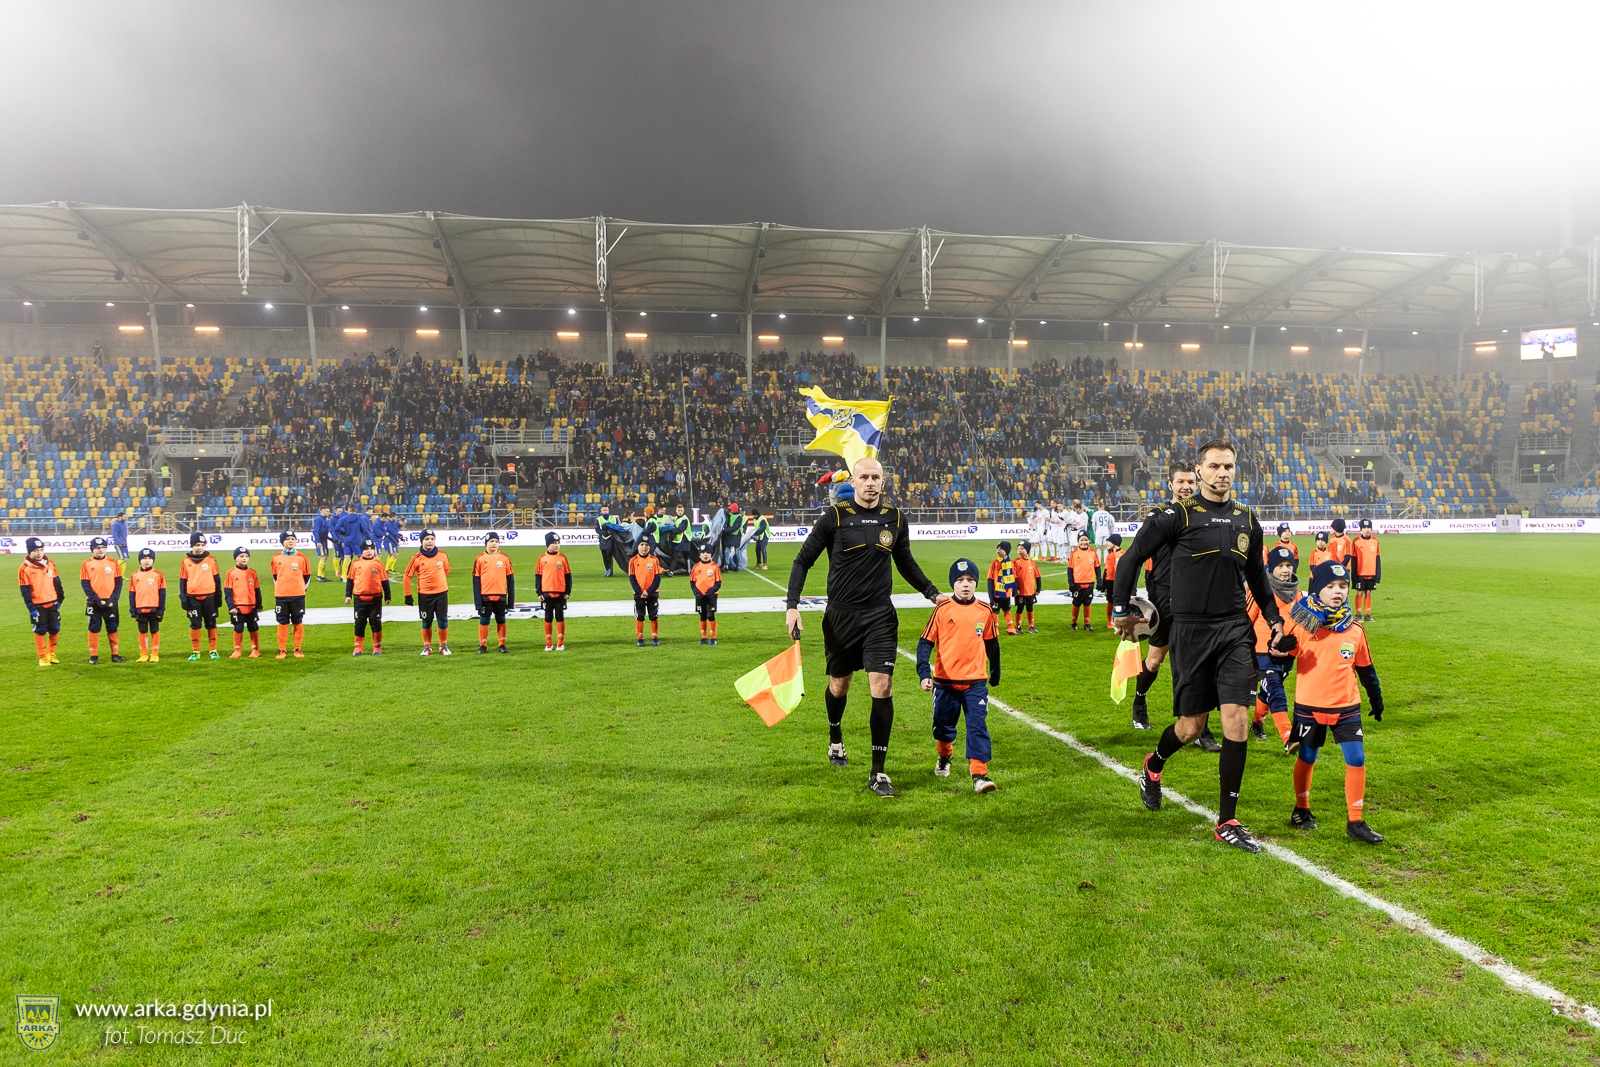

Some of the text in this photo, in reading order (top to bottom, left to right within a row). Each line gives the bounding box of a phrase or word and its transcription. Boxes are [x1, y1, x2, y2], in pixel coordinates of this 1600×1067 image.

[225, 445, 236, 453] 14
[553, 444, 563, 453] 15
[1098, 515, 1108, 526] 95
[1298, 724, 1311, 738] 17
